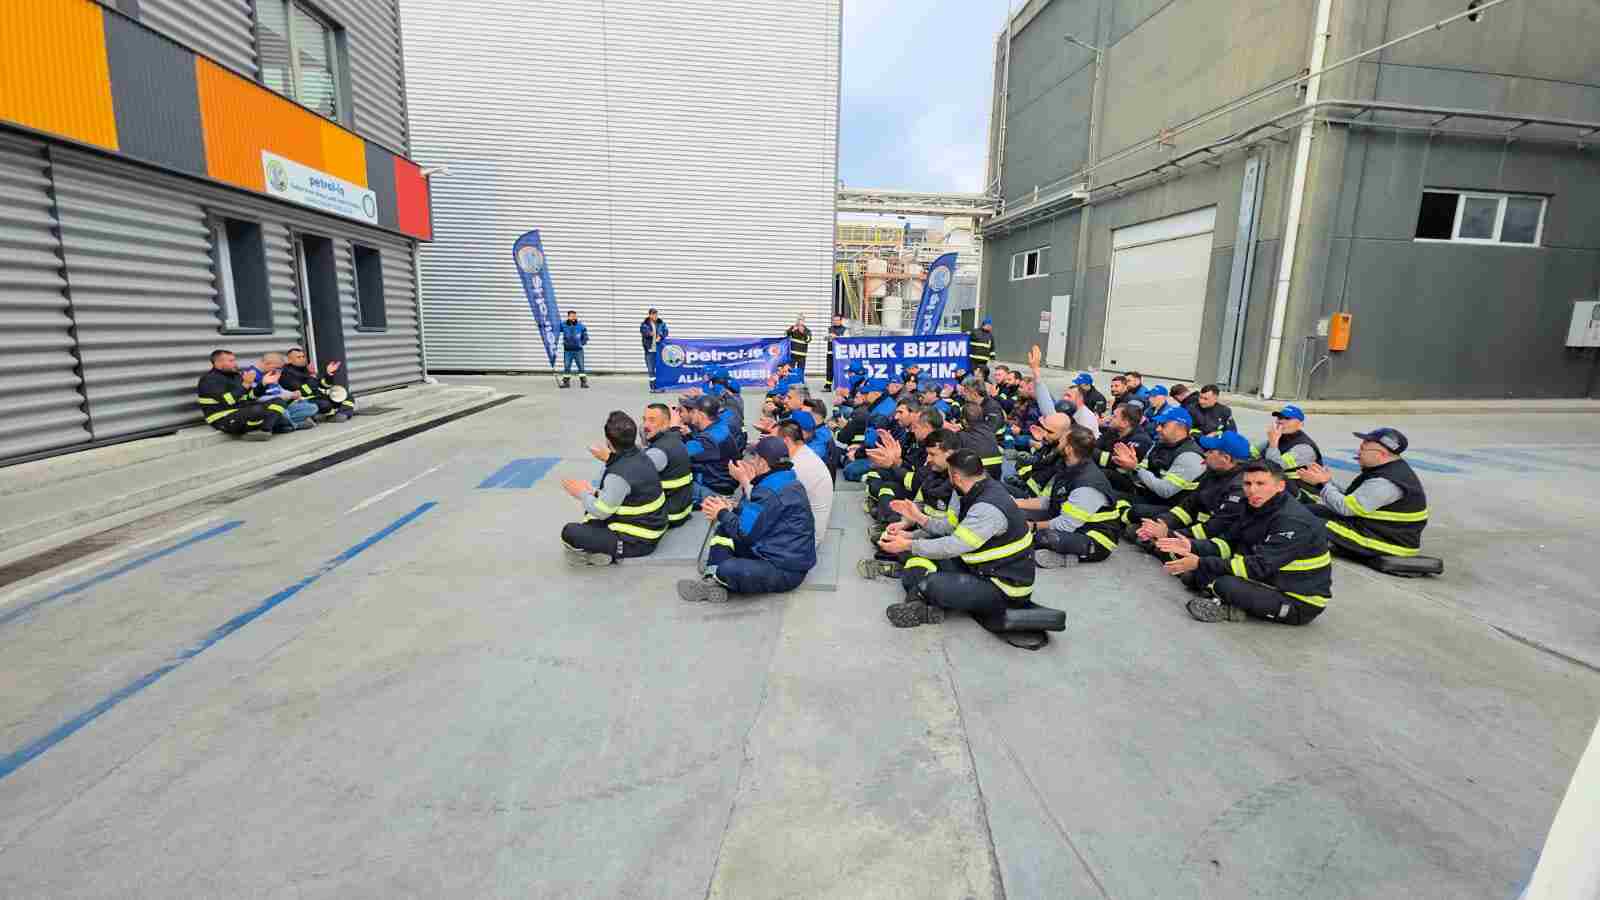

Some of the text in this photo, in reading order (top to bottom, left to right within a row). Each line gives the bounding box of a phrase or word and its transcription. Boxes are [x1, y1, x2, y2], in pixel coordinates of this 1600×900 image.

[835, 339, 967, 360] EMEK BİZİM
[844, 359, 889, 379] ÖZ
